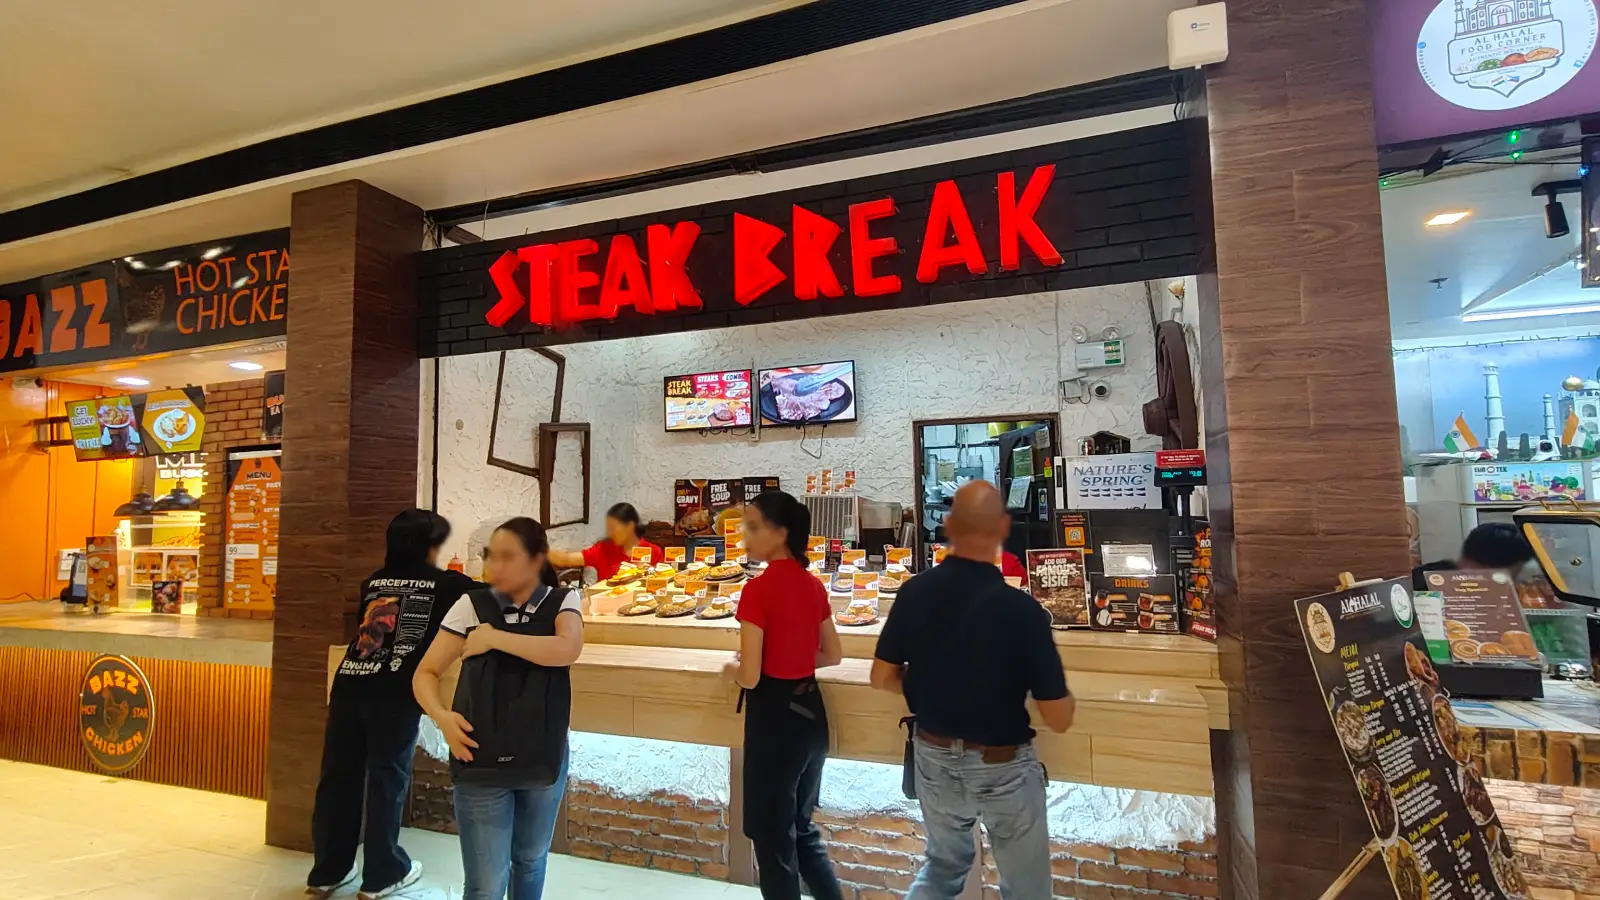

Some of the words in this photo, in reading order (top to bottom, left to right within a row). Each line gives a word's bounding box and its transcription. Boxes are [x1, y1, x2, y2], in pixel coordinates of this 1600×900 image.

[1474, 36, 1489, 45] AL
[1493, 27, 1534, 41] HALAL
[1460, 43, 1493, 55] FOOD
[1498, 33, 1547, 48] CORNER
[485, 220, 703, 328] STEAK
[734, 163, 1066, 307] BREAK
[174, 256, 236, 295] HOT
[176, 284, 287, 336] CHICKE
[668, 380, 691, 389] STEAK
[668, 387, 692, 396] BREAK
[246, 471, 272, 480] MENU
[1073, 464, 1152, 476] NATURE'S
[1081, 476, 1143, 487] SPRING
[710, 483, 728, 493] FREE
[744, 484, 761, 493] FREE
[676, 495, 699, 504] GRAVY
[710, 492, 731, 503] SOUP
[229, 546, 237, 555] 99
[1035, 563, 1077, 577] FAMOUS
[368, 578, 436, 589] PERCEPTION
[1041, 575, 1068, 588] SISIG
[1114, 578, 1149, 589] DRINKS
[89, 670, 140, 695] BAZZ
[81, 704, 98, 716] HOT
[132, 706, 149, 719] STAR
[85, 726, 144, 756] CHICKEN
